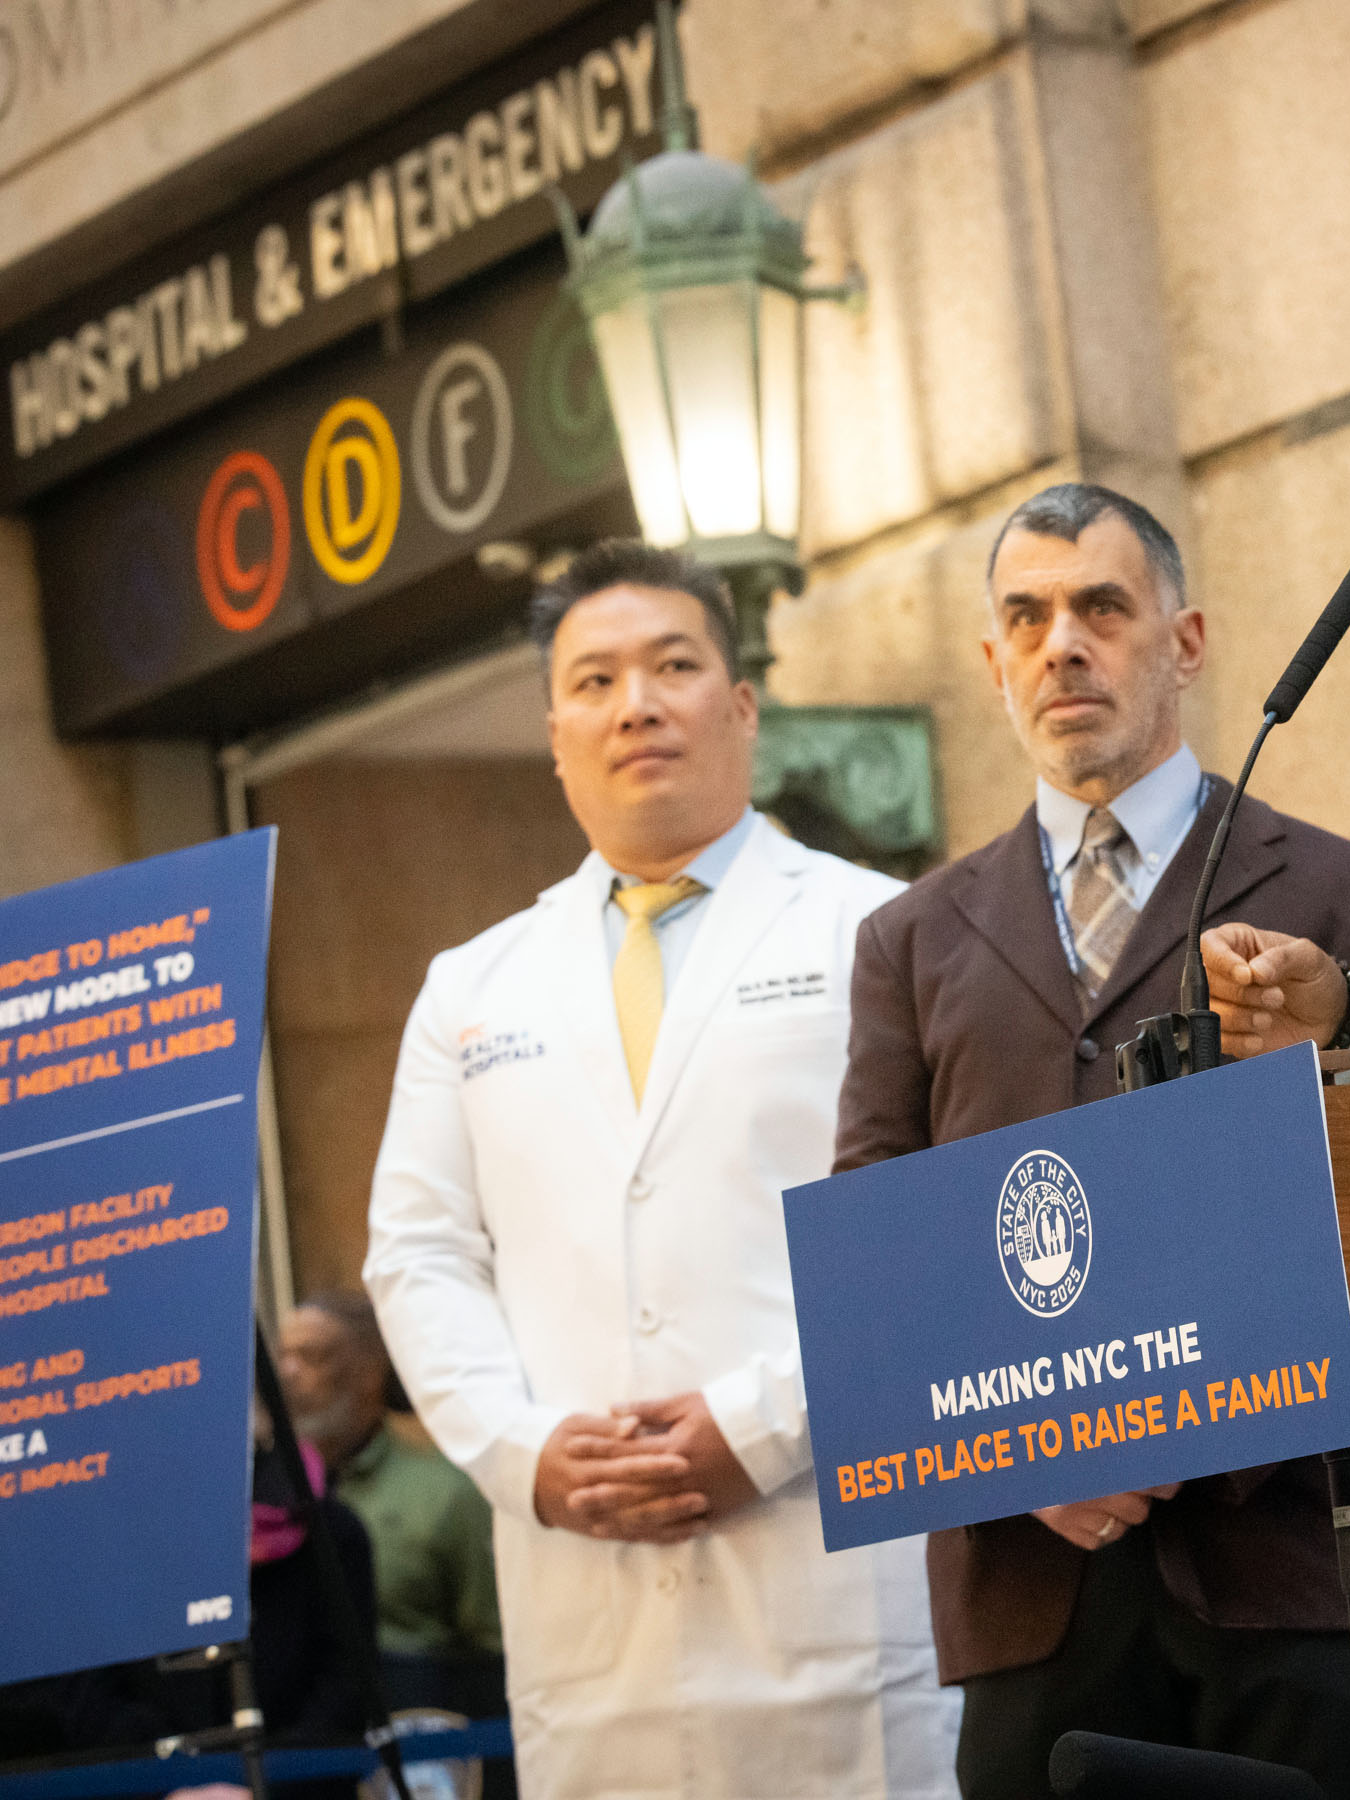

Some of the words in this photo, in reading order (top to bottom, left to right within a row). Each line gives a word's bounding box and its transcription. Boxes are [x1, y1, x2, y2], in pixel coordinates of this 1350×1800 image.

[10, 252, 248, 458] HOSPITAL
[255, 223, 304, 328] &
[310, 22, 655, 298] EMERGENCY
[54, 964, 152, 1014] MODEL
[153, 951, 195, 985] TO
[66, 938, 103, 970] TO
[16, 1003, 142, 1061] PATIENTS
[148, 983, 222, 1025] WITH
[16, 1050, 122, 1100] MENTAL
[128, 1018, 236, 1071] ILLNESS
[69, 1182, 174, 1230] FACILITY
[72, 1206, 229, 1266] DISCHARGED
[1002, 1184, 1020, 1258] STATE
[1017, 1162, 1034, 1187] OF
[1039, 1160, 1067, 1189] THE
[1066, 1185, 1087, 1239] CITY
[1019, 1277, 1046, 1309] NYC
[1050, 1265, 1081, 1309] 2025
[31, 1349, 85, 1383] AND
[74, 1358, 200, 1411] SUPPORTS
[930, 1356, 1056, 1421] MAKING
[1061, 1339, 1129, 1391] NYC
[1133, 1322, 1202, 1373] THE
[26, 1429, 48, 1459] A
[836, 1452, 907, 1503] BEST
[914, 1433, 1014, 1486] PLACE
[1018, 1418, 1063, 1463] TO
[1070, 1394, 1167, 1452] RAISE
[1176, 1389, 1201, 1430] A
[1206, 1357, 1331, 1423] FAMILY
[20, 1451, 110, 1493] IMPACT
